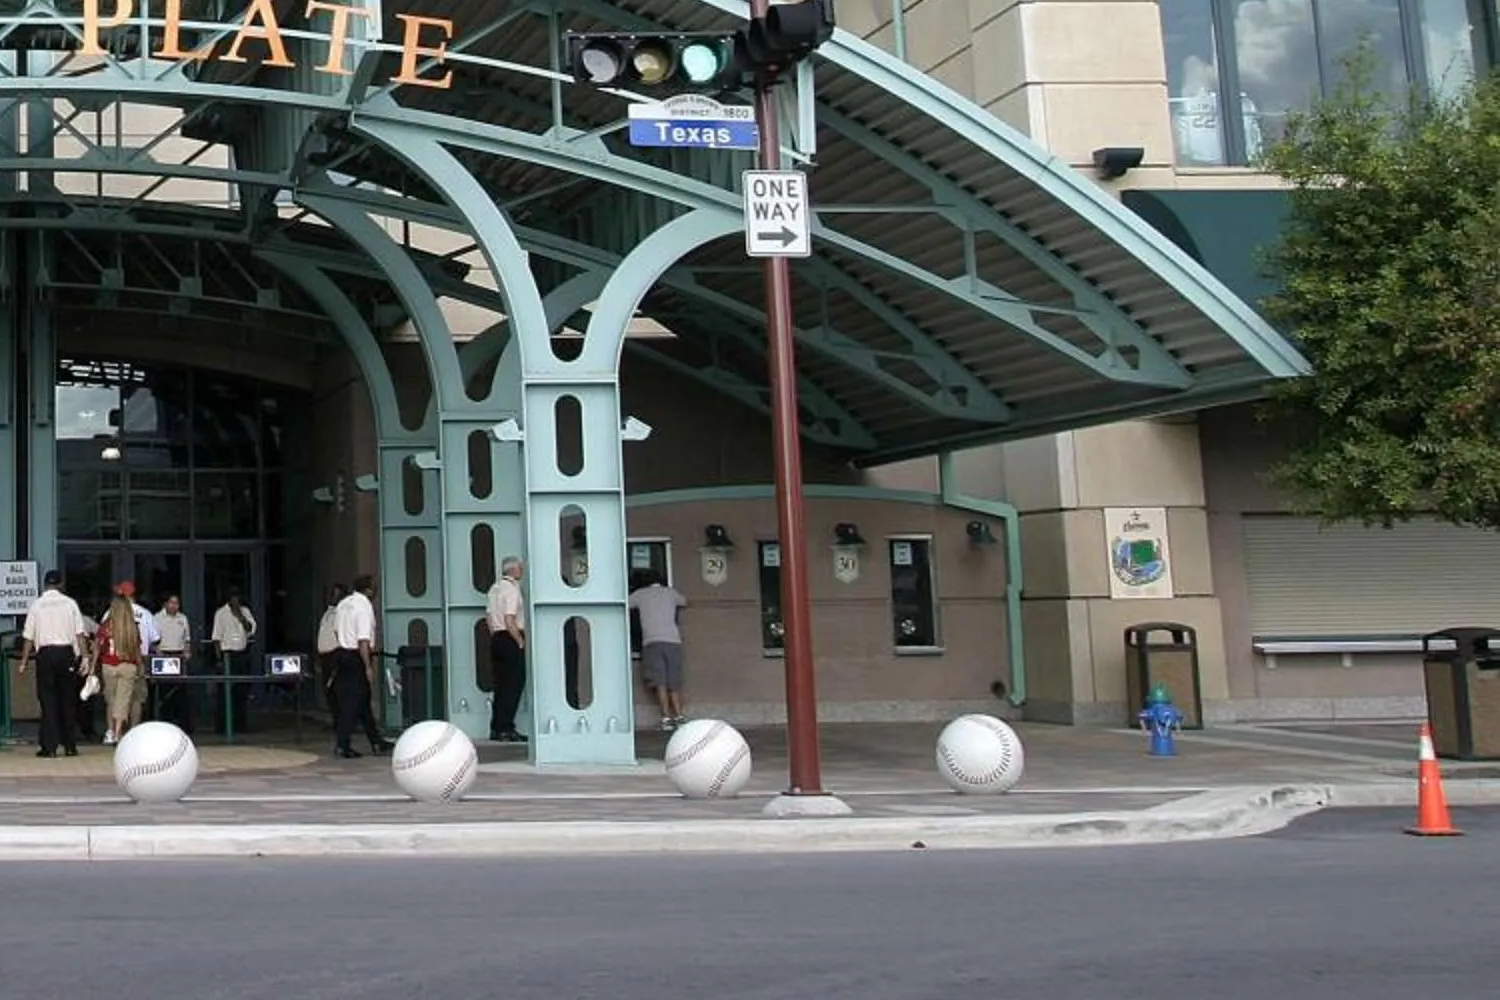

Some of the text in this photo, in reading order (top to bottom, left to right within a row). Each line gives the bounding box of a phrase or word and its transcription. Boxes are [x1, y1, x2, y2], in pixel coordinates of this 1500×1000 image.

[654, 122, 732, 144] Texas
[753, 178, 799, 198] ONE
[753, 202, 800, 221] WAY
[706, 557, 724, 575] 29
[838, 556, 855, 573] 30
